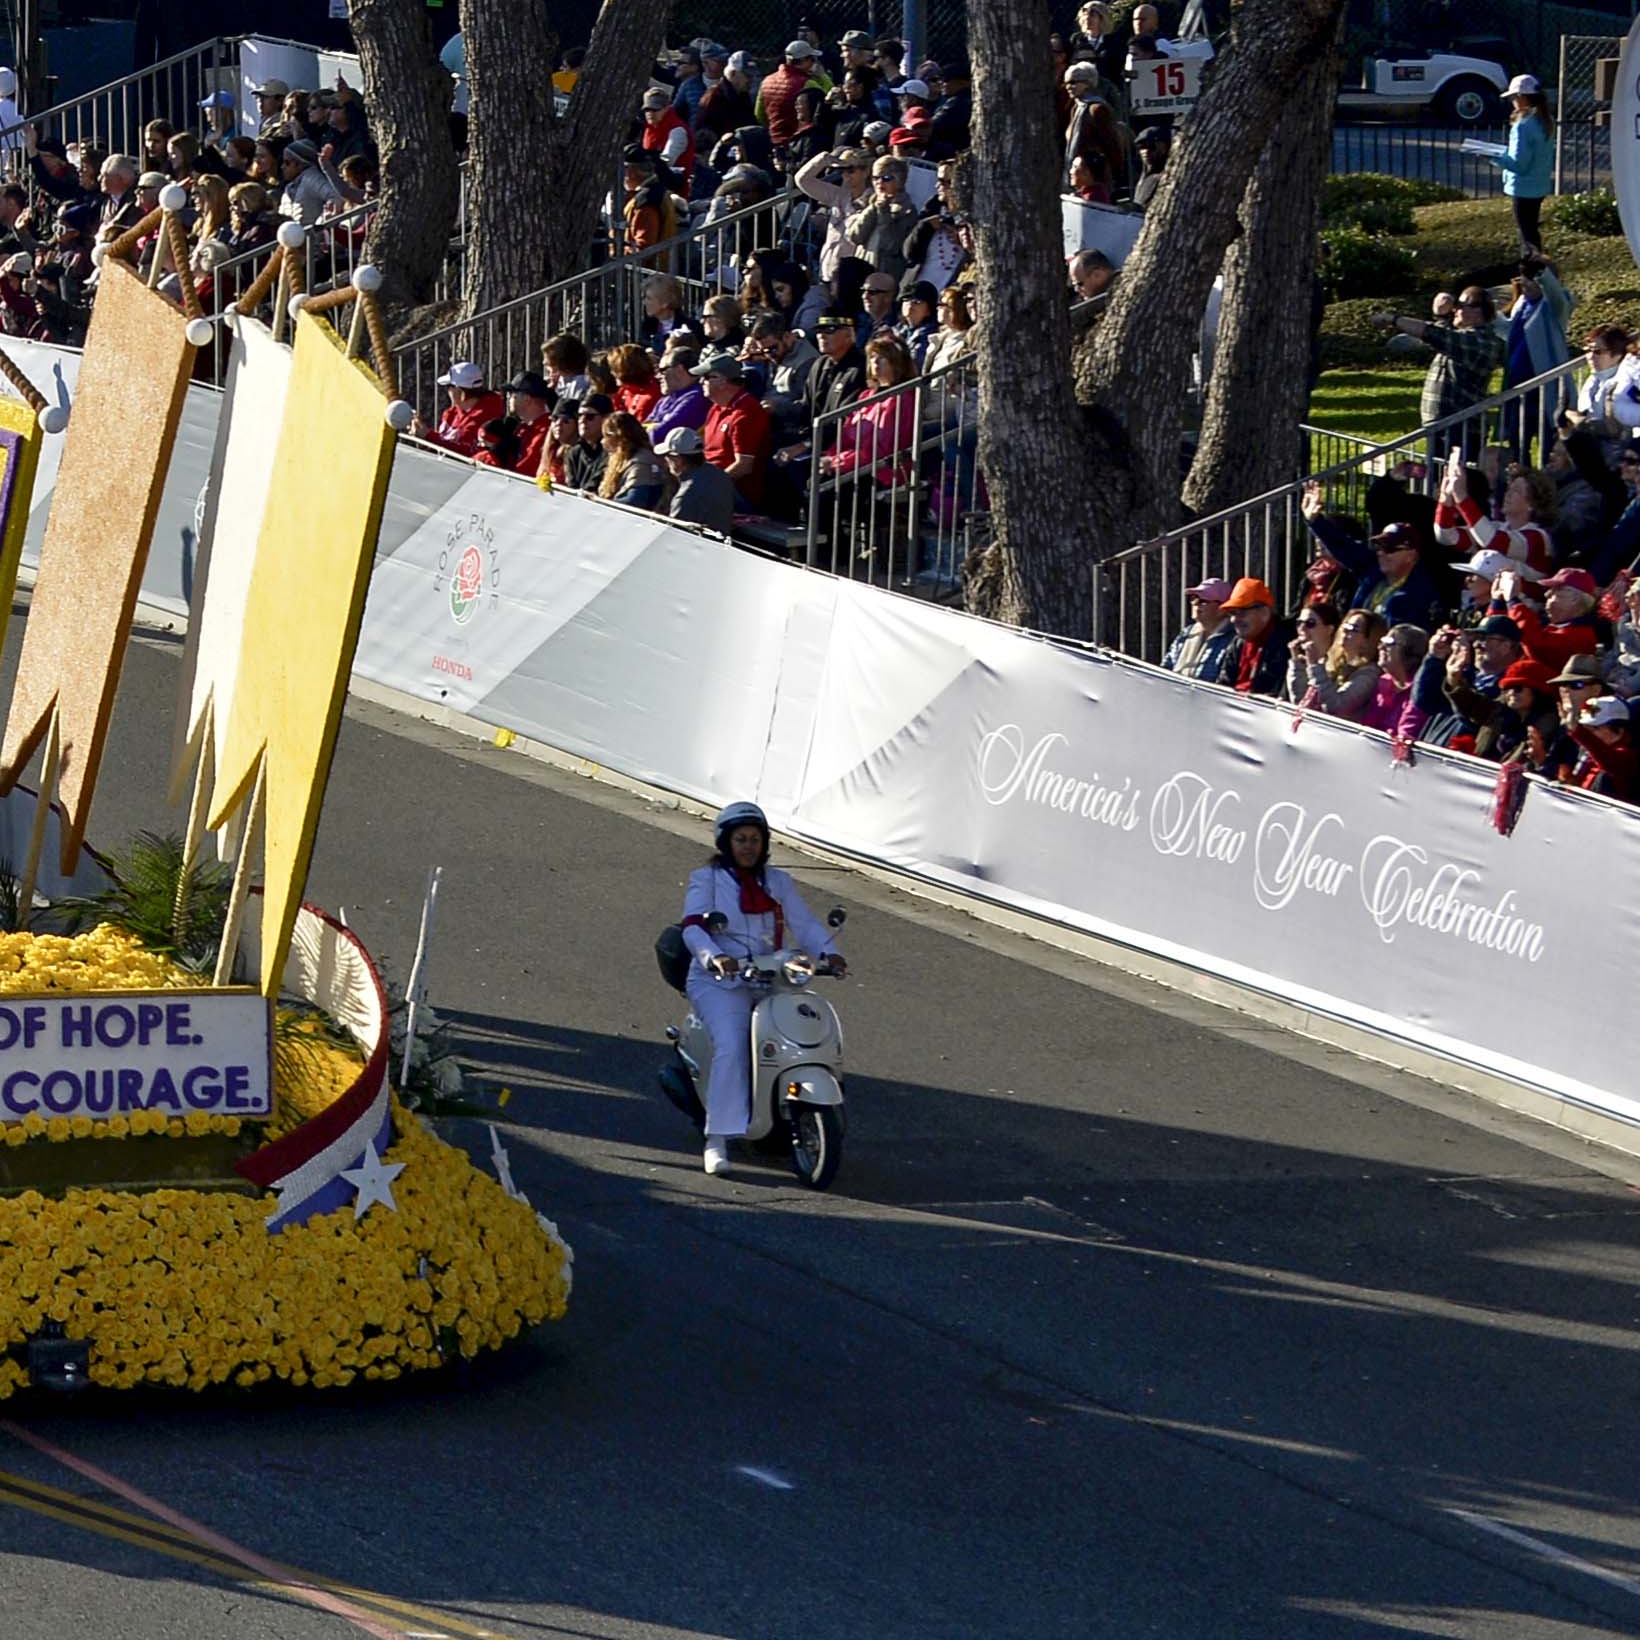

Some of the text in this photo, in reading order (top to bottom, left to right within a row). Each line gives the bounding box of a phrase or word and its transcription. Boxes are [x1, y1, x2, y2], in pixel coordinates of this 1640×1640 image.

[1152, 62, 1185, 97] 15
[431, 655, 473, 681] HONDA
[977, 722, 1546, 962] America's New Year Celebration
[61, 1002, 204, 1050] HOPE.
[1, 1064, 264, 1115] COURAGE.
